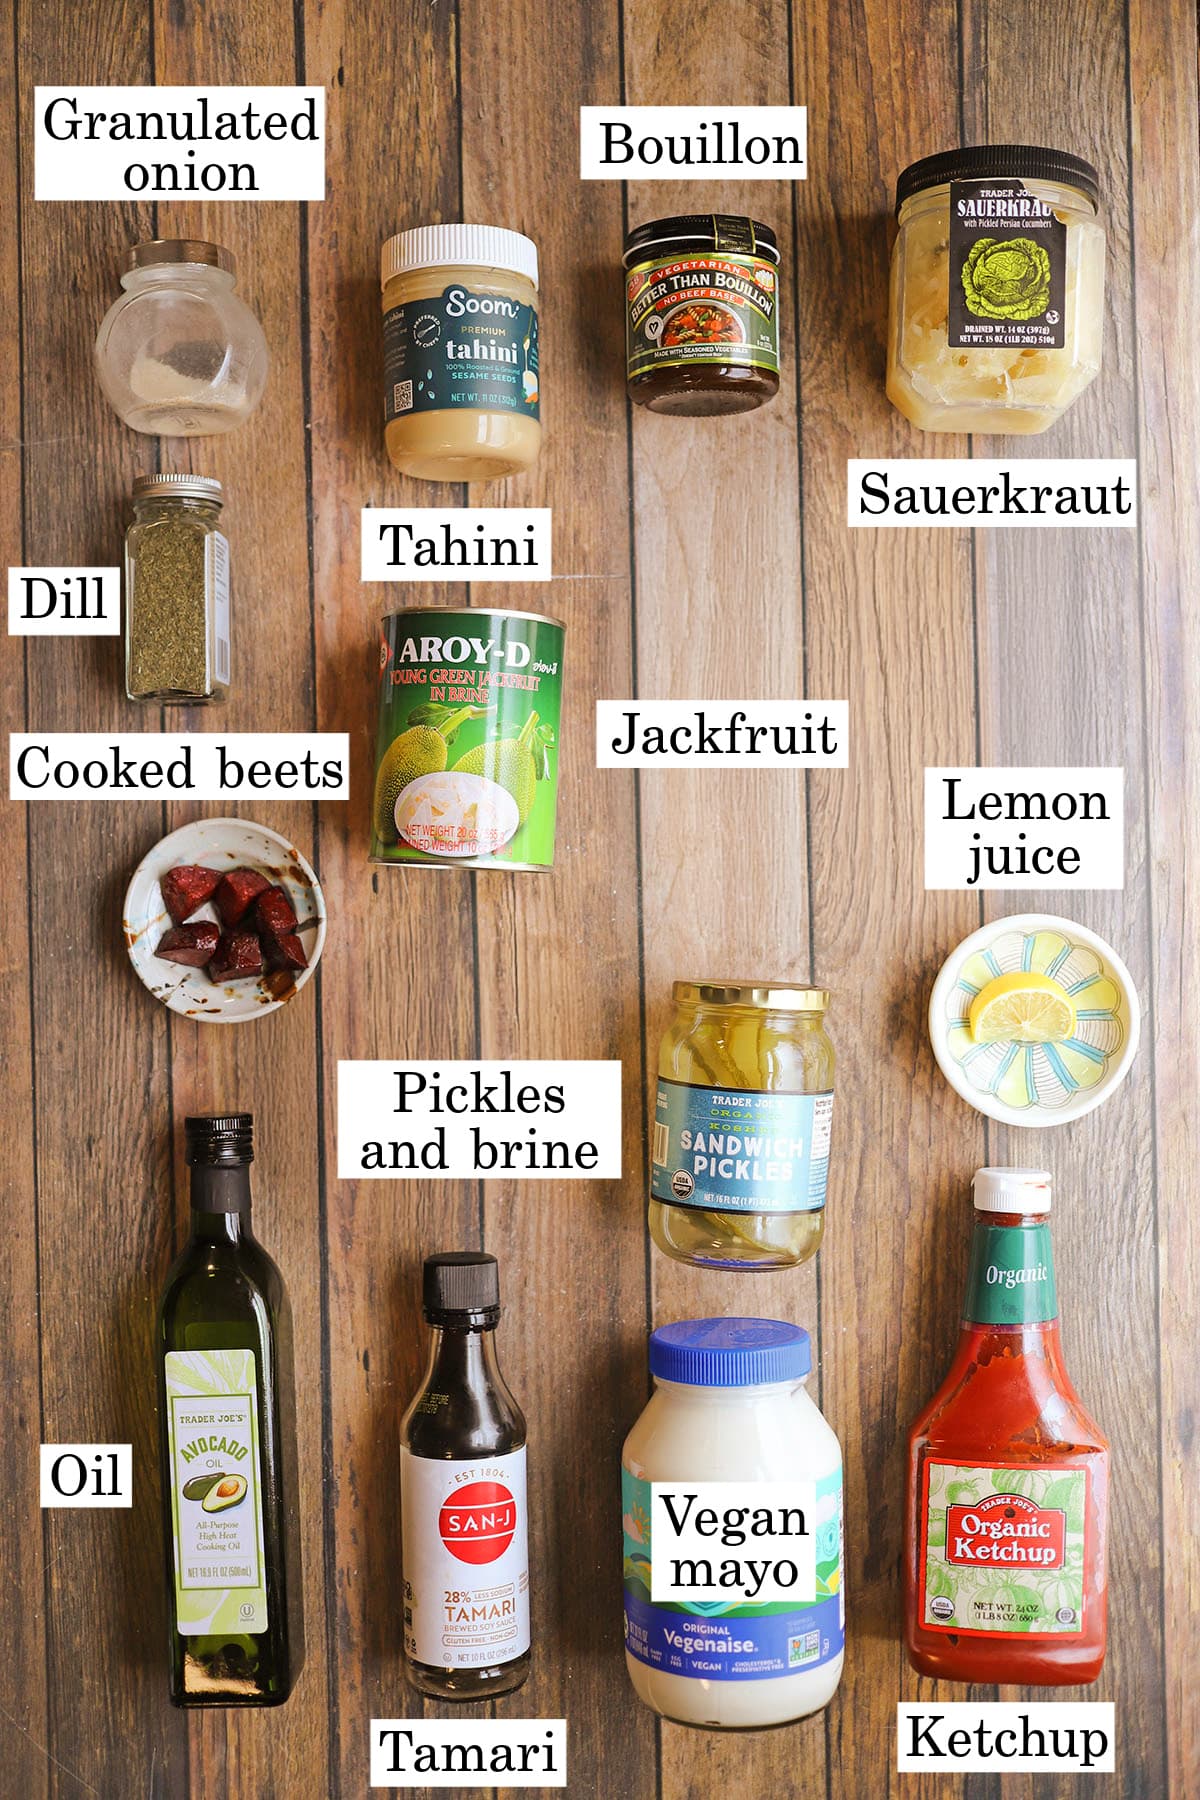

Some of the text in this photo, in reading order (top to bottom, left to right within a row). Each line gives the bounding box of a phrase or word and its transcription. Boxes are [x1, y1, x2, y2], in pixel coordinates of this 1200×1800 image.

[980, 189, 1014, 198] TRADER
[957, 199, 1055, 217] SAUERKRAU
[964, 219, 1052, 228] with Pickled Persian Cucumbers
[657, 260, 740, 278] VEGETARIAN
[631, 282, 667, 322] BETTER
[670, 274, 710, 290] THAN
[715, 272, 773, 316] BOUILLON
[663, 290, 735, 305] NO BEEF BASE
[445, 289, 519, 319] Soom
[461, 326, 506, 337] PREMIUM
[965, 325, 993, 333] DRAINED
[995, 325, 1007, 333] WT.
[1026, 326, 1050, 335] (397g)
[960, 335, 971, 343] NET
[972, 335, 985, 343] WT.
[1038, 336, 1055, 345] 510g
[446, 339, 518, 364] tahini
[452, 372, 517, 384] SESAME SEEDS
[451, 393, 466, 402] NET
[467, 394, 480, 402] WT.
[400, 637, 530, 668] AROY-D
[390, 669, 541, 691] YOUNG GREEN JACKFRUIT
[430, 687, 489, 703] IN BRINE
[405, 824, 421, 835] NET
[423, 825, 455, 838] WEIGHT
[457, 826, 467, 838] 20
[431, 840, 465, 851] WEIGHT
[467, 841, 476, 853] 10
[712, 1095, 752, 1107] TRADER
[680, 1130, 804, 1158] SANDWICH
[693, 1155, 793, 1182] PICKLES
[986, 1263, 1047, 1289] Organic
[180, 1414, 243, 1423] TRADER JOE'S
[180, 1436, 248, 1463] AVOCADO
[205, 1459, 223, 1468] OIL
[455, 1468, 504, 1483] EST 1804
[981, 1498, 1034, 1513] TRADER JOE'S
[196, 1521, 239, 1530] All-Purpose
[449, 1509, 510, 1532] SAN-J
[961, 1514, 1050, 1540] Organic
[199, 1532, 216, 1541] High
[196, 1542, 240, 1551] Cooking Oil
[954, 1537, 1056, 1565] Ketchup
[188, 1567, 198, 1577] NET
[213, 1567, 219, 1577] FL
[220, 1567, 227, 1577] OZ
[444, 1591, 471, 1603] 28%
[444, 1597, 515, 1622] TAMARI
[973, 1602, 993, 1610] NET
[1015, 1604, 1025, 1613] 24
[982, 1612, 994, 1620] LB
[1002, 1613, 1018, 1621] OZ)
[444, 1616, 516, 1632] BREWED SOY SAUCE
[683, 1623, 730, 1635] ORIGINAL
[457, 1654, 470, 1662] NET
[692, 1661, 722, 1671] VEGAN
